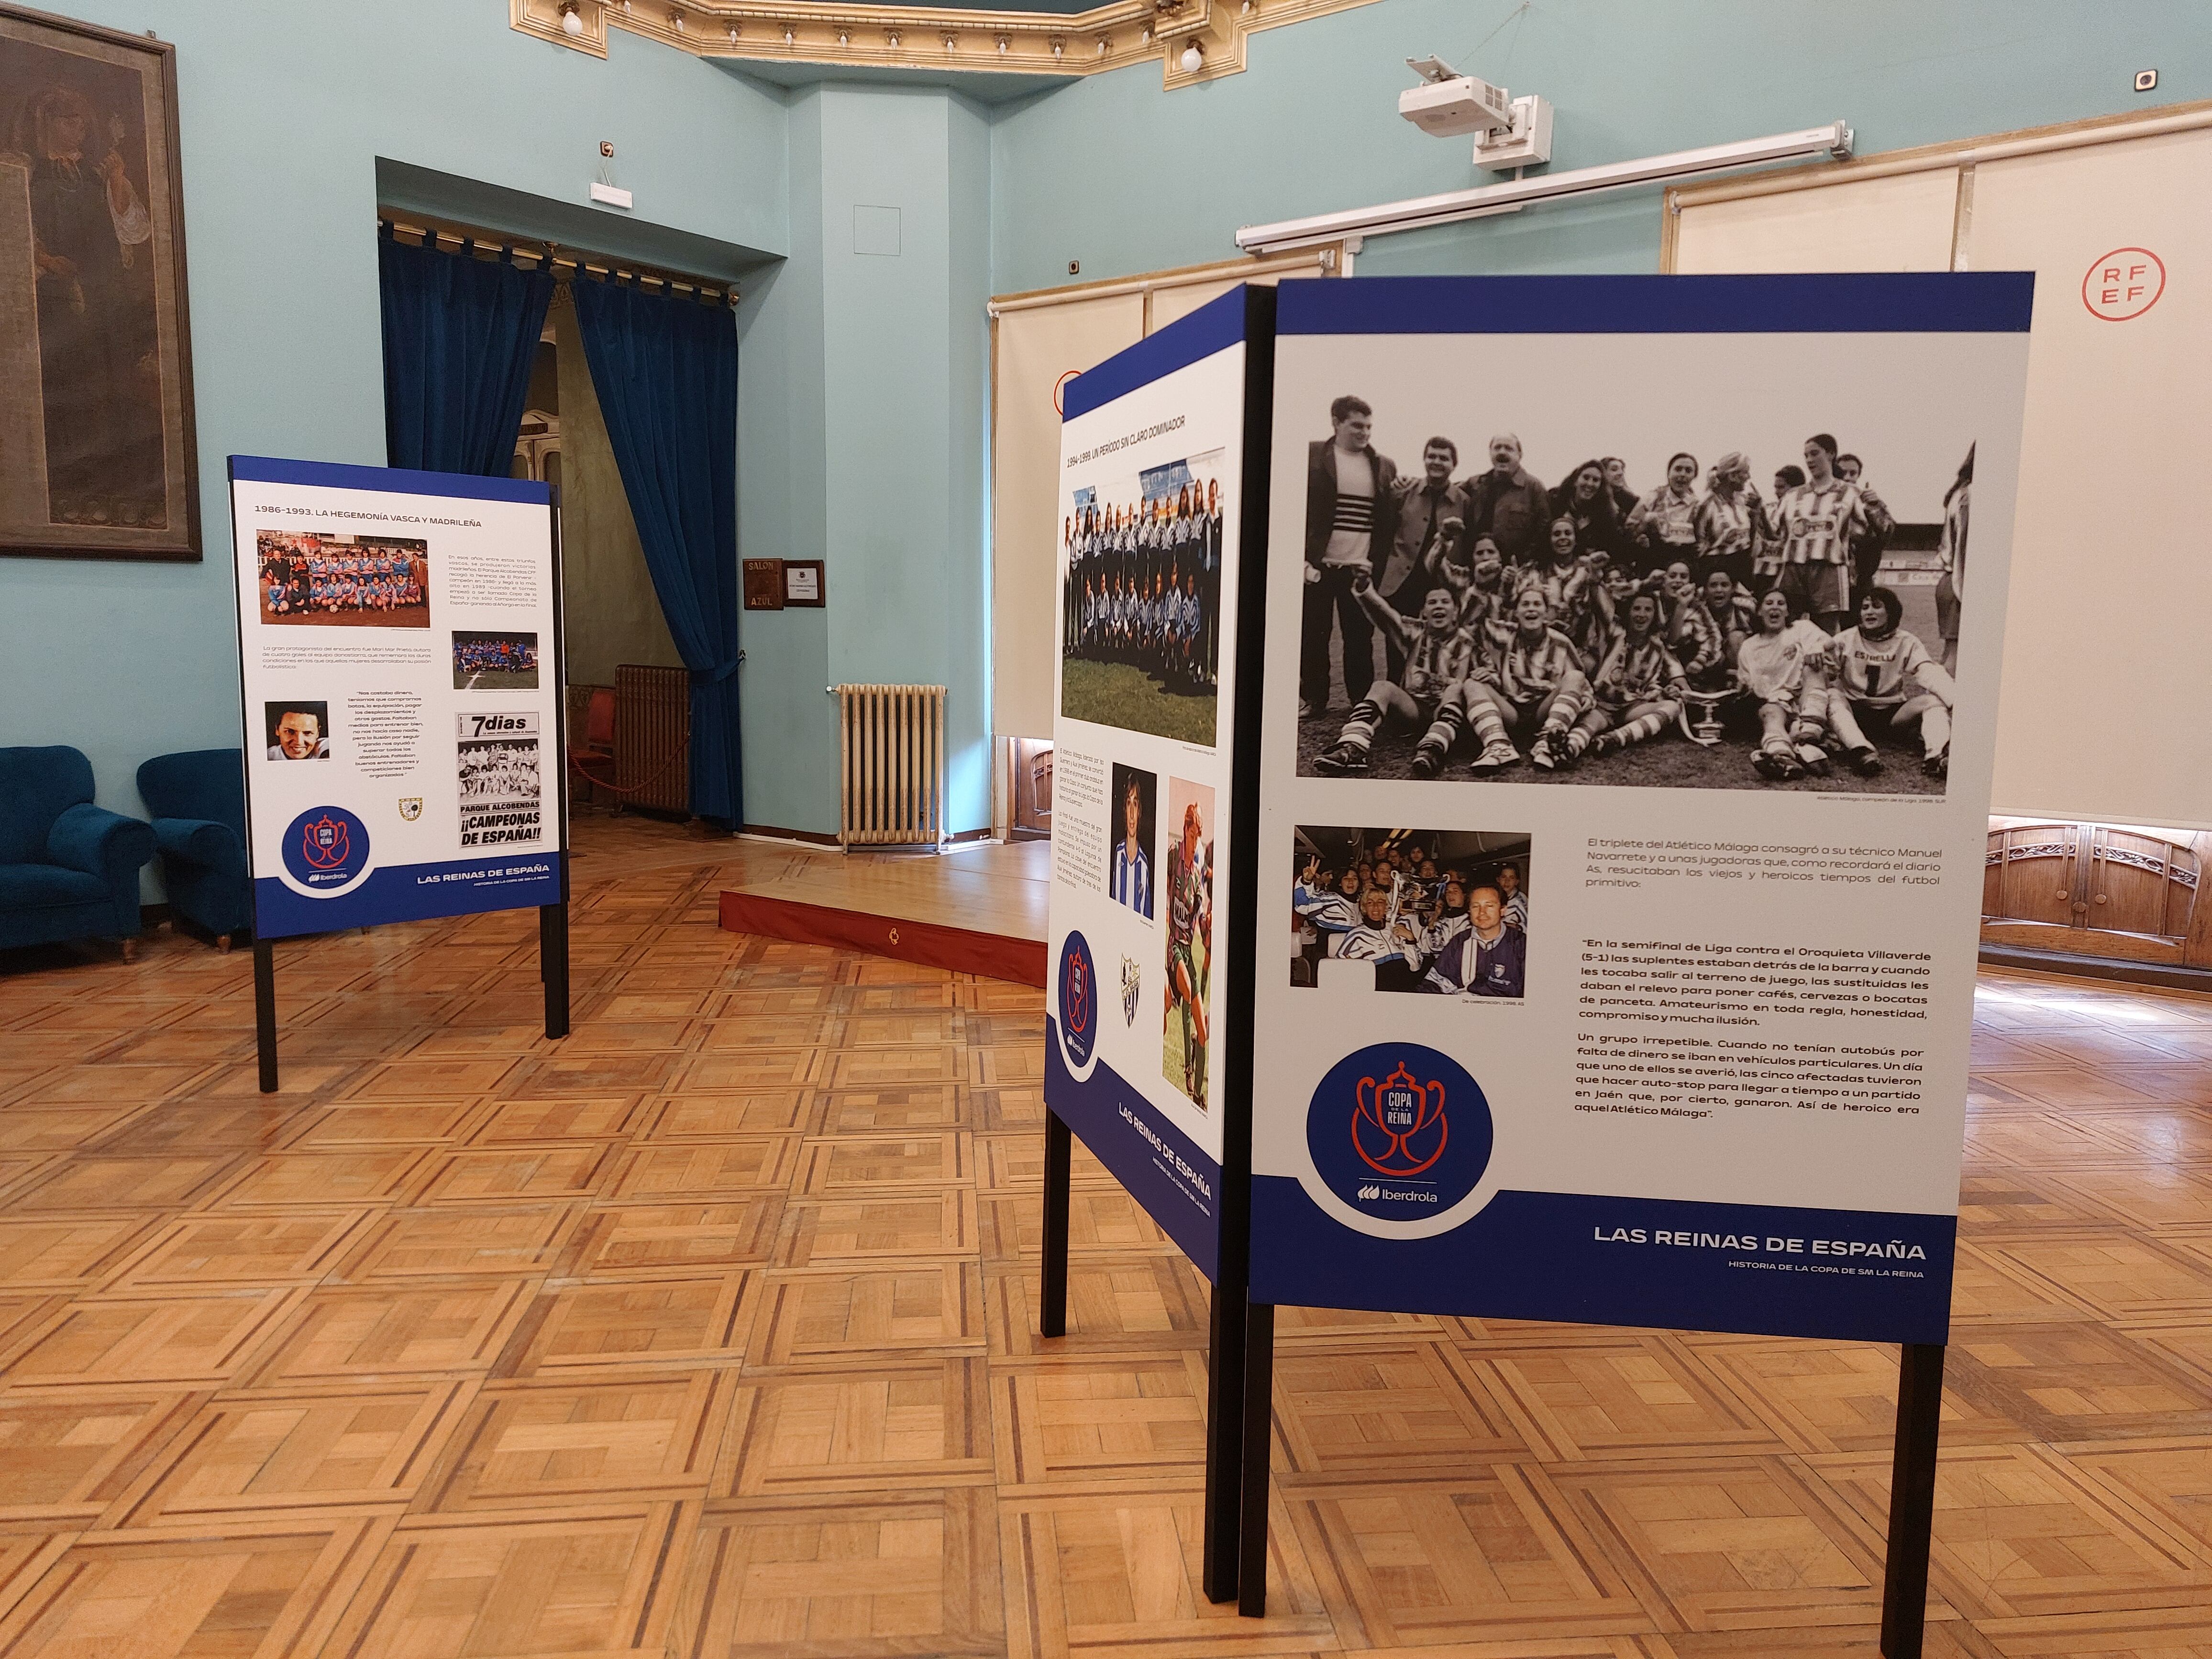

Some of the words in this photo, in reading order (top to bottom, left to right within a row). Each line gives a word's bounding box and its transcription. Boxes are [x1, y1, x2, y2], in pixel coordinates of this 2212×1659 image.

[1092, 448, 1098, 459] UN
[1121, 436, 1129, 449] SIN
[1130, 429, 1148, 446] CLARO
[1149, 415, 1185, 438] DOMINADOR
[254, 505, 313, 516] 1986-1993.
[330, 510, 389, 521] HEGEMONÍA
[389, 514, 420, 523] VASCA
[429, 517, 482, 527] MADRILEÑA
[751, 597, 773, 606] AZUL
[1865, 664, 1881, 697] 1
[460, 805, 490, 813] PARQUE
[492, 801, 540, 810] ALCOBENDAS
[462, 832, 479, 845] DE
[482, 825, 541, 844] ESPAÑA!!
[1588, 838, 1597, 846] El
[1599, 839, 1644, 849] triplete
[1645, 840, 1663, 849] del
[1665, 841, 1712, 850] Atlético
[1714, 842, 1759, 854] Málaga
[1761, 845, 1819, 856] consagró
[1848, 846, 1895, 856] técnico
[1897, 848, 1942, 858] Manuel
[1587, 851, 1647, 862] Navarrete
[1648, 855, 1656, 863] y
[1698, 855, 1761, 866] jugadoras
[1764, 859, 1789, 867] que,
[1791, 860, 1827, 868] como
[1829, 860, 1891, 870] recordará
[1892, 861, 1903, 870] el
[1905, 862, 1941, 872] diario
[417, 875, 440, 884] LAS
[443, 871, 485, 881] REINAS
[488, 869, 503, 877] DE
[506, 864, 549, 875] ESPAÑA
[1607, 866, 1680, 875] resucitaban
[1686, 867, 1703, 877] los
[1709, 869, 1742, 879] viejos
[1748, 872, 1756, 880] y
[1761, 870, 1814, 881] heroicos
[1819, 873, 1871, 884] tiempos
[1877, 874, 1895, 884] del
[1901, 875, 1940, 885] futbol
[1606, 939, 1617, 948] la
[1621, 940, 1681, 951] semifinal
[1685, 943, 1701, 951] de
[1705, 943, 1732, 954] Liga
[1736, 946, 1780, 954] contra
[1783, 947, 1794, 955] el
[1798, 947, 1864, 959] Oroquieta
[1867, 950, 1931, 961] Villaverde
[1388, 1092, 1412, 1108] COPA
[1574, 1104, 1609, 1113] aquel
[1610, 1105, 1659, 1115] Atlético
[1594, 1090, 1623, 1099] Jaén
[1628, 1093, 1655, 1102] que,
[1660, 1095, 1683, 1103] por
[1688, 1095, 1729, 1106] cierto,
[1734, 1099, 1792, 1108] ganaron.
[1796, 1100, 1816, 1109] Así
[1821, 1101, 1837, 1110] de
[1843, 1102, 1891, 1113] heroico
[1387, 1112, 1412, 1126] REINA
[1119, 1102, 1132, 1124] LAS
[1134, 1116, 1161, 1153] REINAS
[1162, 1143, 1174, 1164] DE
[1176, 1155, 1212, 1200] ESPAÑA
[1382, 1189, 1438, 1203] Iberdrola
[1594, 1226, 1647, 1243] LAS
[1655, 1230, 1758, 1250] REINAS
[1765, 1237, 1804, 1253] DE
[1812, 1239, 1926, 1260] ESPAÑA
[1728, 1260, 1776, 1270] HISTORIA
[1810, 1265, 1839, 1274] COPA
[1891, 1270, 1924, 1278] REINA
